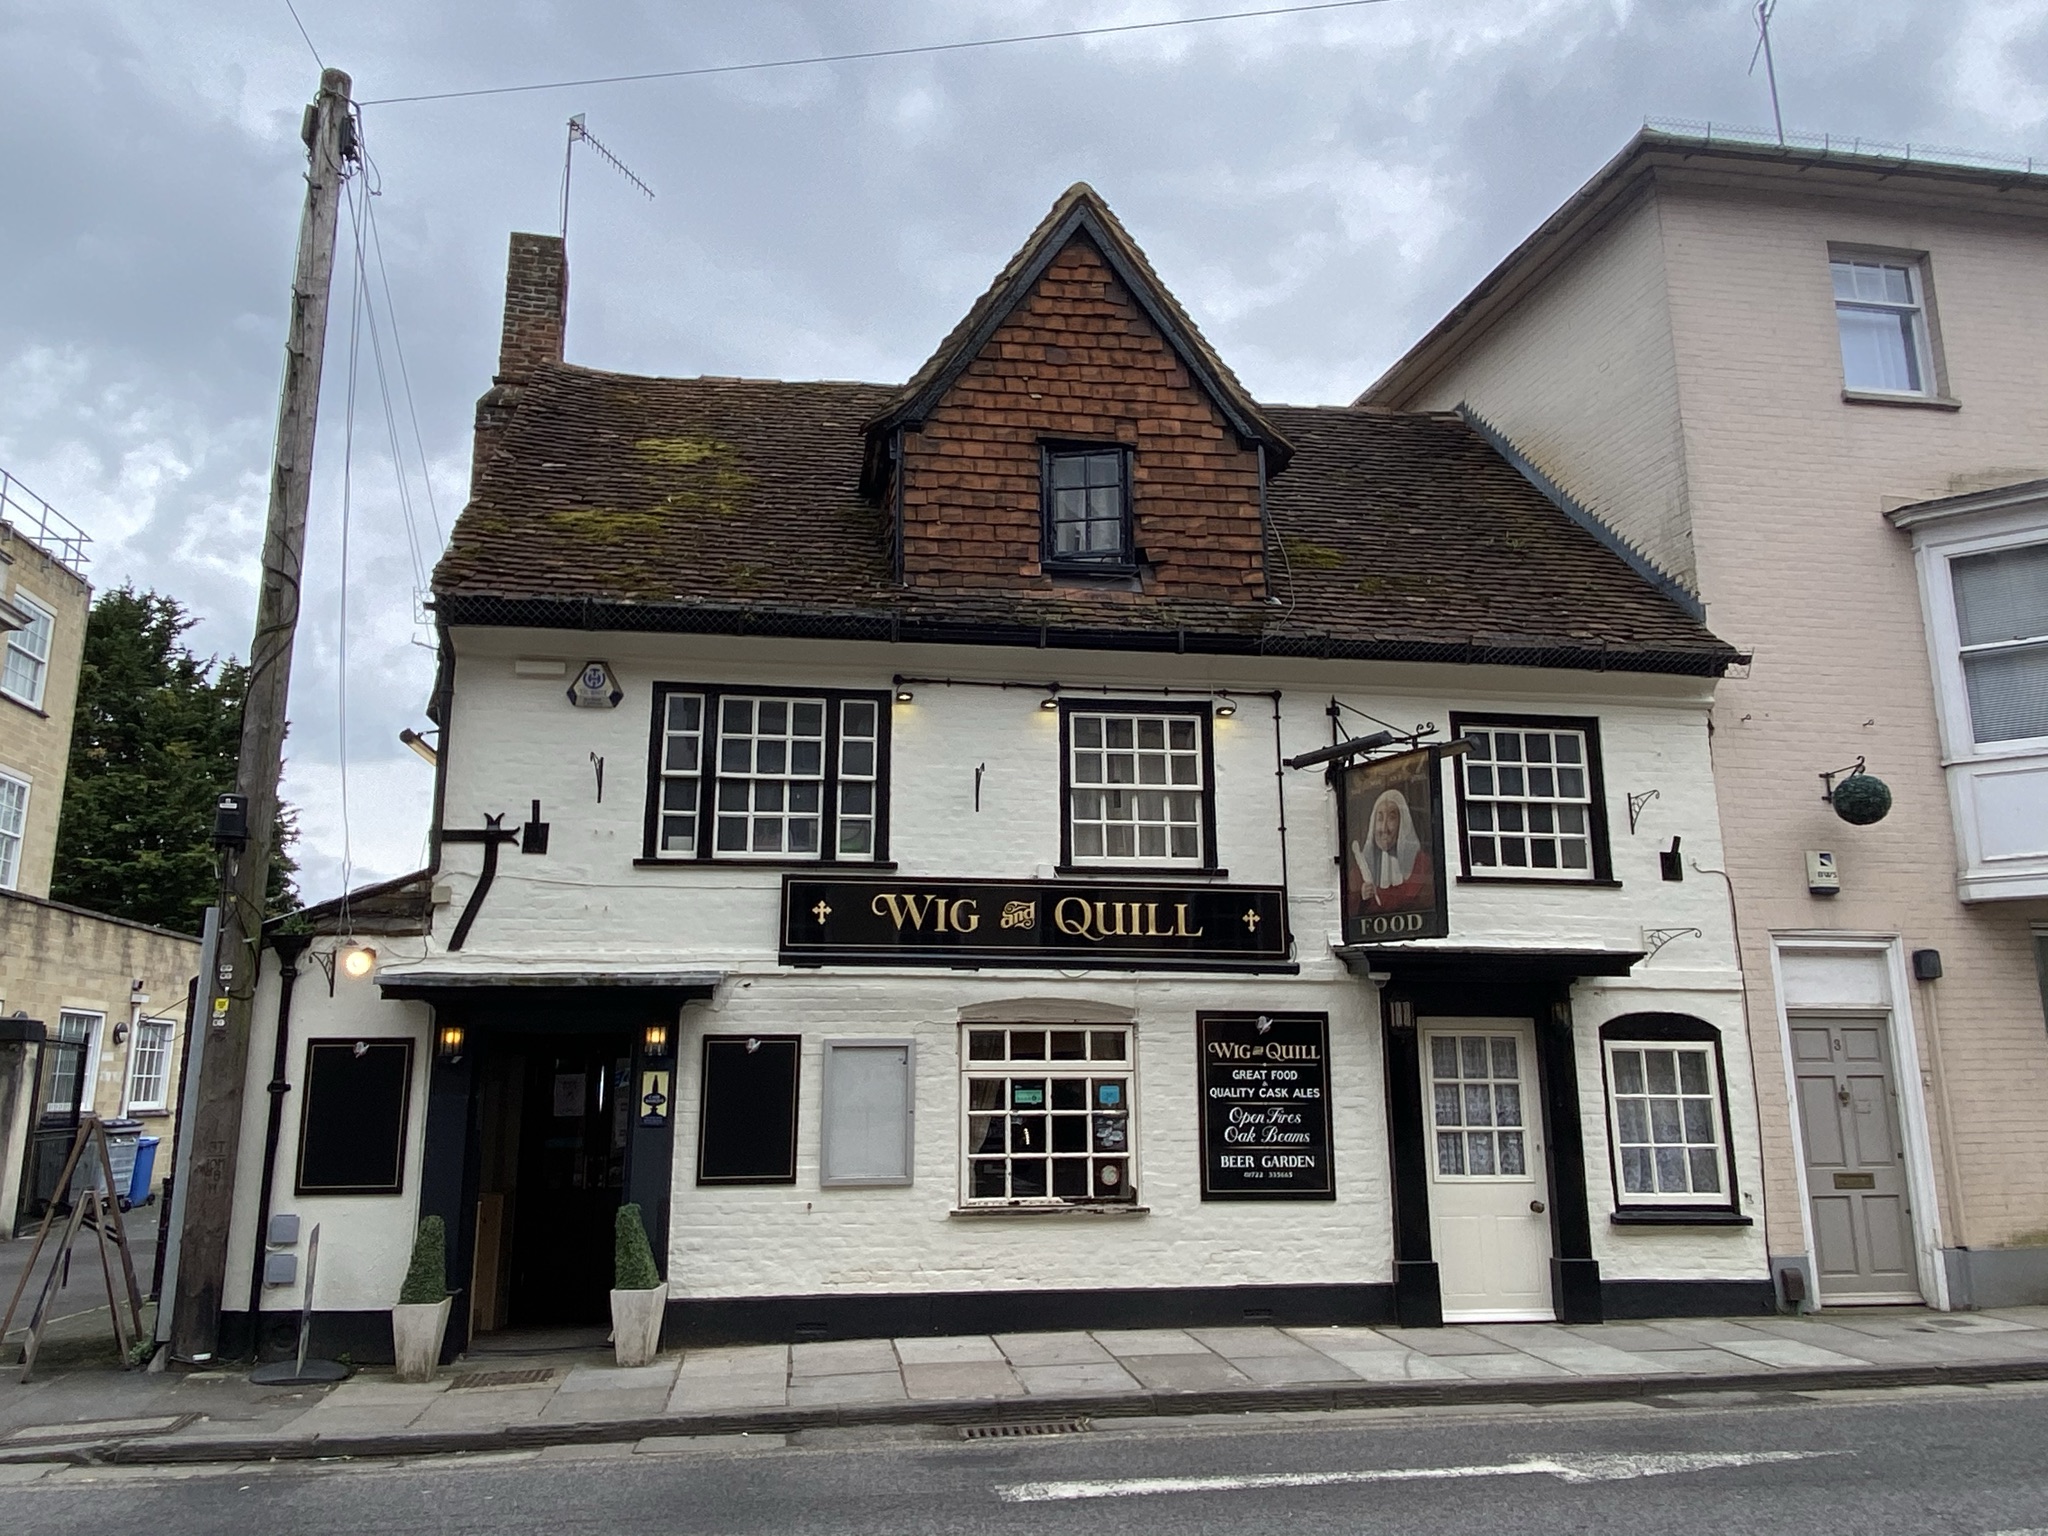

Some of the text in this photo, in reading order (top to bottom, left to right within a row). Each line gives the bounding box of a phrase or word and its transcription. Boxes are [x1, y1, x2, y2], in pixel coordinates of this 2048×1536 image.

[872, 893, 1203, 941] WIG and QUILL
[1360, 914, 1423, 935] FOOD
[1208, 1042, 1251, 1059] WIG
[1265, 1042, 1320, 1062] QUILL
[1833, 1038, 1841, 1051] 3
[1232, 1069, 1298, 1080] GREAT FOOD
[1209, 1087, 1320, 1099] QUALITY CASK ALES
[1229, 1106, 1302, 1128] Open Fires
[1224, 1125, 1310, 1143] Oak Beams
[1220, 1155, 1315, 1168] BEER GARDEN
